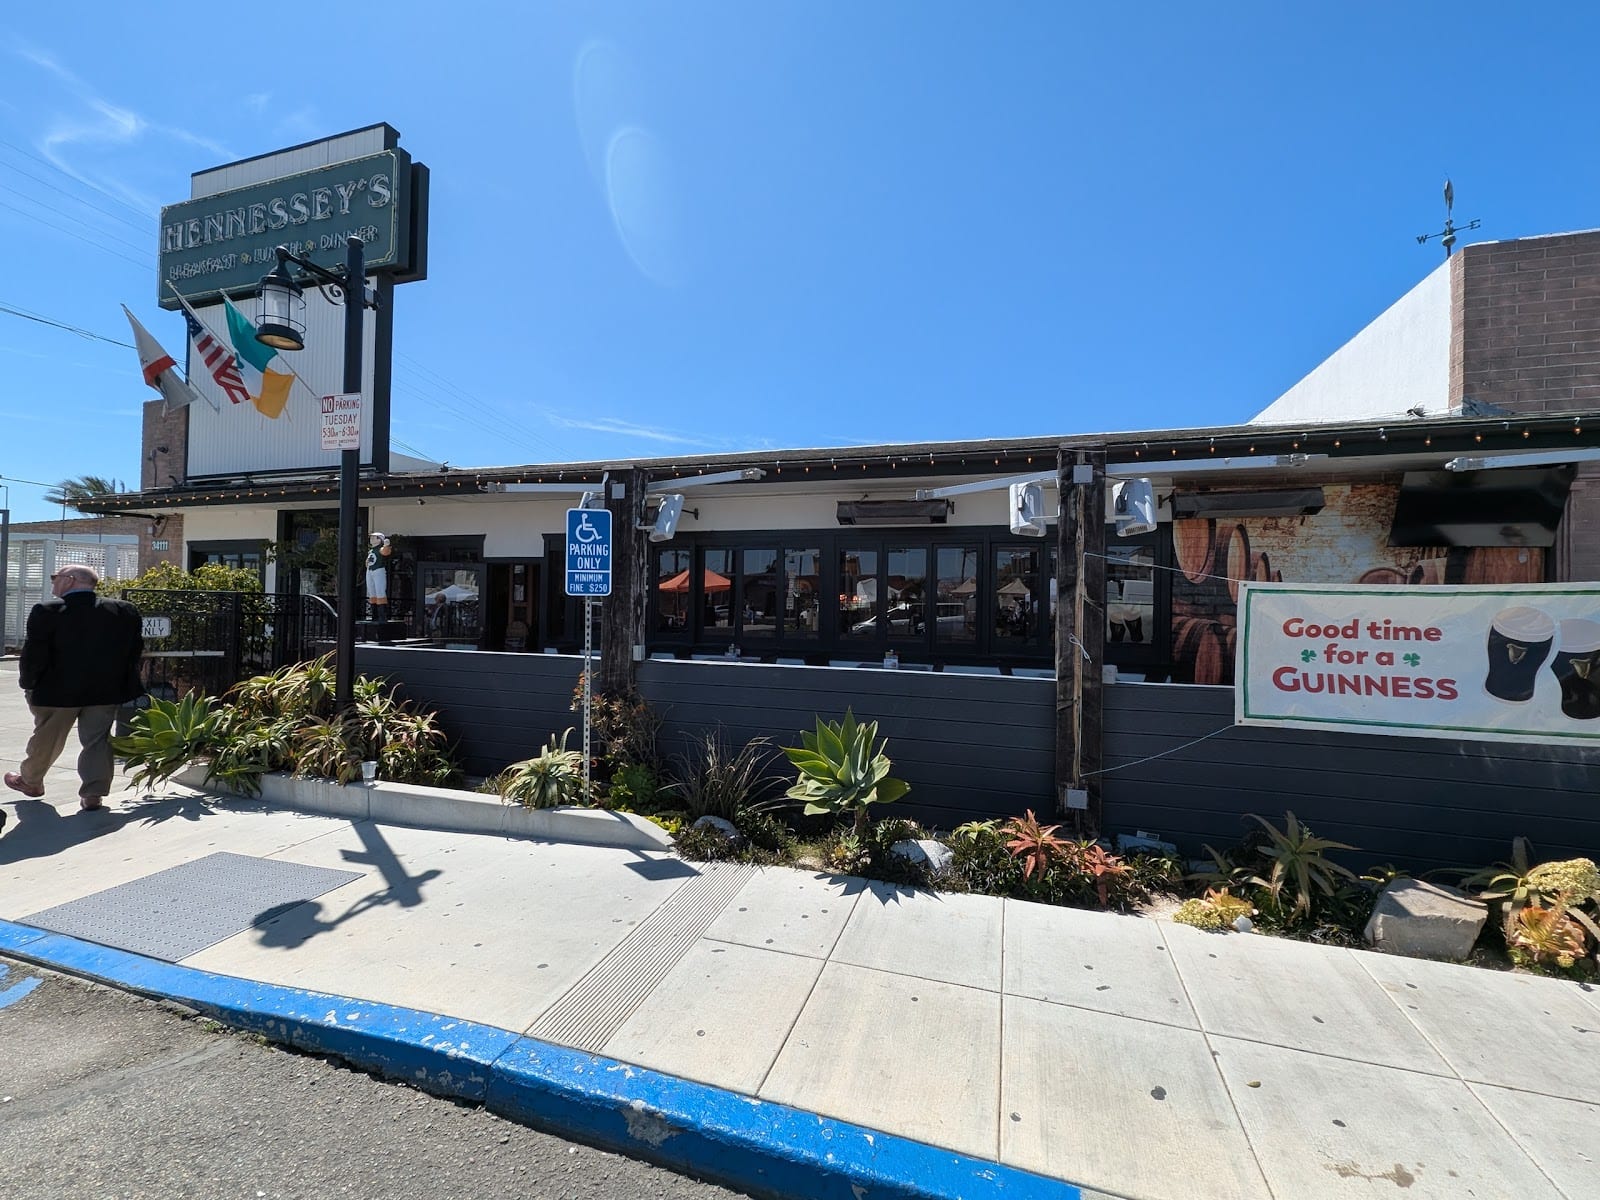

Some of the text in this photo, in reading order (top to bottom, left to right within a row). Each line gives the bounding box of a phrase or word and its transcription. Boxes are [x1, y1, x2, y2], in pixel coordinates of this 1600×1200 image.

[162, 173, 391, 253] HENNESSEY'S
[169, 253, 238, 280] BREAKFAST
[253, 241, 302, 264] LUNH
[322, 398, 360, 412] NO PARKING
[325, 413, 357, 425] TUESDAY
[151, 540, 168, 551] 34111
[569, 543, 609, 556] PARKING
[577, 556, 601, 570] ONLY
[574, 573, 603, 582] MINIMUM
[569, 583, 608, 592] FINE $250
[145, 619, 162, 627] XIT
[1282, 617, 1443, 641] Good time
[143, 627, 164, 636] NLY
[1323, 643, 1395, 666] for a
[1272, 666, 1459, 701] GUINNESS
